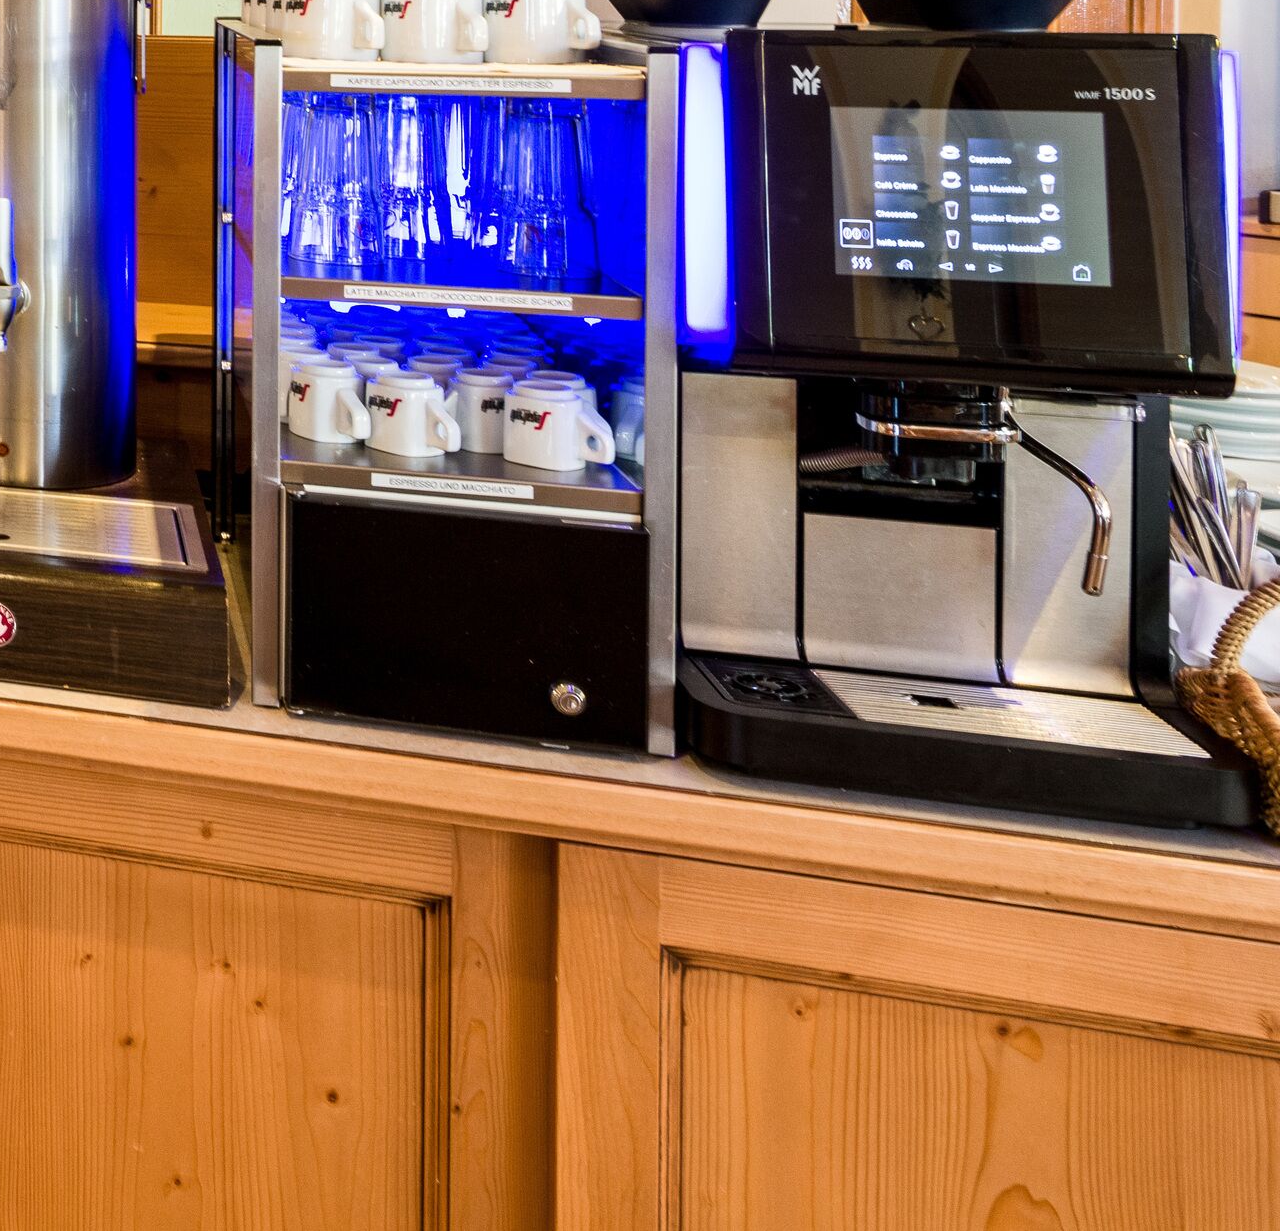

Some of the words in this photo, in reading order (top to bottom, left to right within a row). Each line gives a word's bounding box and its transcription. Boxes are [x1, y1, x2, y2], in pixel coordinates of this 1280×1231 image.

[347, 78, 382, 86] KAFFEE
[384, 79, 444, 88] CAPPUCCINO
[446, 80, 500, 88] DOPPELTER
[502, 80, 554, 89] ESPRESSO
[1074, 90, 1101, 100] WMF
[1104, 87, 1145, 101] 1500
[1145, 88, 1156, 101] S
[874, 153, 908, 162] Espresso
[969, 155, 1012, 165] Cappuccino
[345, 288, 373, 297] LATTE
[375, 289, 429, 300] MACCHIATO
[495, 295, 529, 305] HEISSE
[530, 297, 572, 307] SCHOKO
[389, 477, 438, 489] ESPRESSO
[461, 483, 516, 495] MACCHIATO
